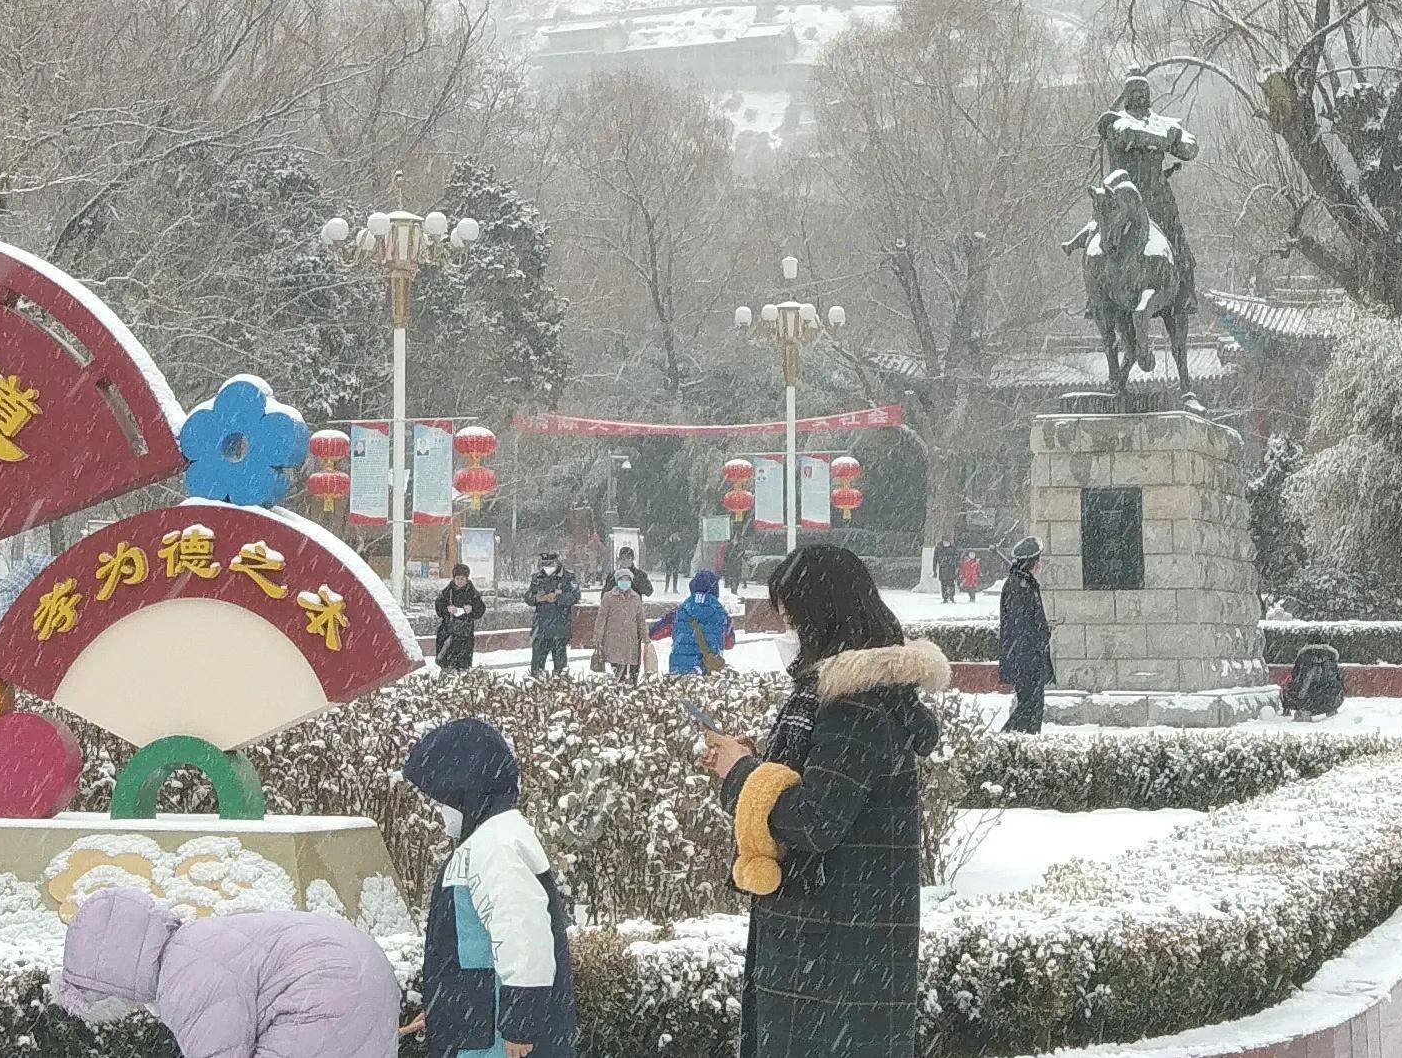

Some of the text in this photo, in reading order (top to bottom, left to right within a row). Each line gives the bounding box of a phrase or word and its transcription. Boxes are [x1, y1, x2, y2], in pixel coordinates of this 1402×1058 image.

[33, 524, 349, 651] 孝为德之本
